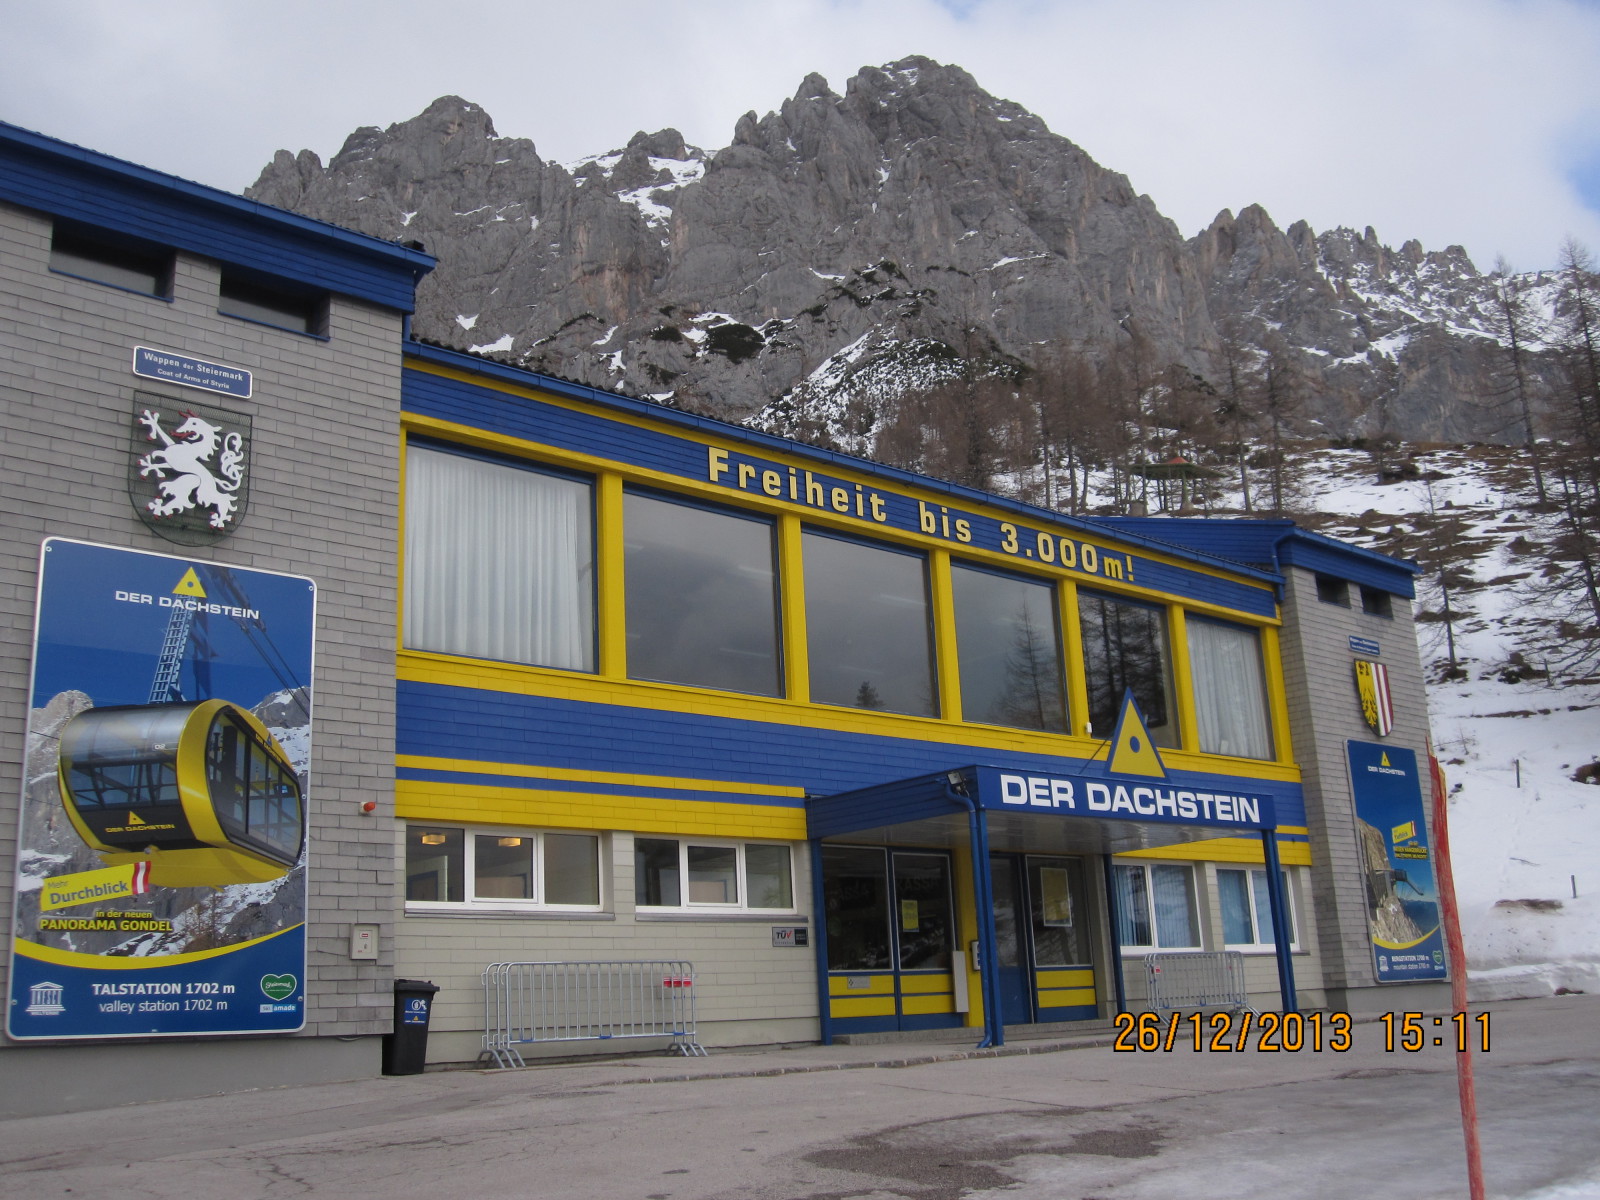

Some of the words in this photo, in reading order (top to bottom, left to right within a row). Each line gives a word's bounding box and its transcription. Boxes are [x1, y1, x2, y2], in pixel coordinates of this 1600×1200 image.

[144, 352, 180, 367] Wappen
[182, 362, 194, 370] der
[196, 364, 243, 381] Steiermark
[157, 368, 174, 377] Coat
[183, 374, 201, 382] Arms
[210, 380, 230, 389] Styria
[708, 446, 887, 522] Freiheit
[918, 500, 972, 542] bis
[115, 590, 153, 604] DER
[158, 596, 260, 620] DACHSTEIN
[1000, 774, 1075, 809] DER
[1086, 782, 1261, 824] DACHSTEIN
[50, 881, 129, 905] Durchblick
[40, 919, 117, 931] PANORAMA
[120, 920, 173, 931] GONDEL
[96, 910, 104, 918] in
[106, 910, 122, 918] der
[91, 983, 182, 995] TALSTATION
[185, 983, 219, 994] 1702
[222, 985, 235, 994] m
[99, 1000, 135, 1014] valley
[138, 1000, 179, 1012] station
[184, 999, 213, 1011] 1702
[216, 1001, 228, 1010] m
